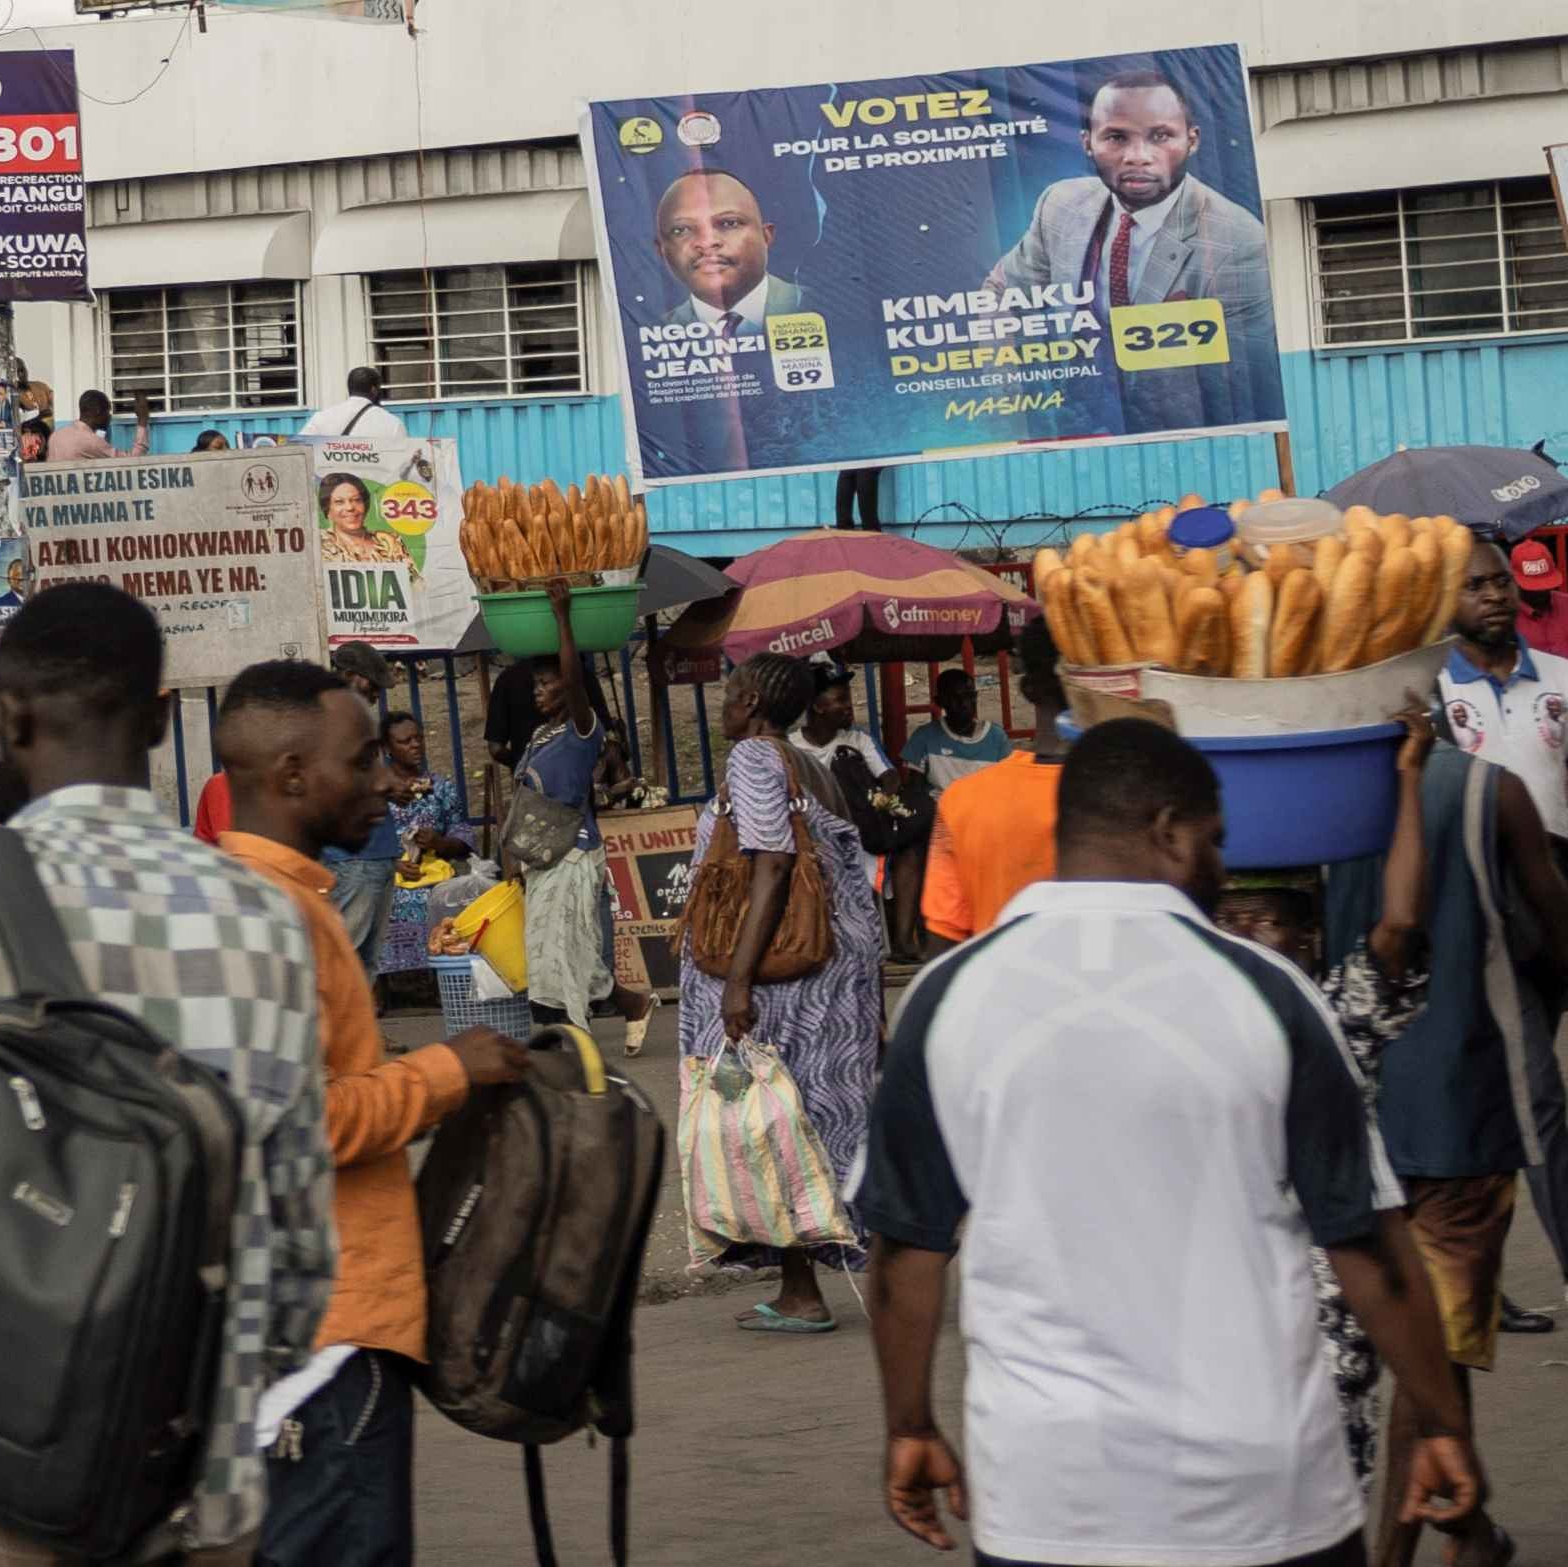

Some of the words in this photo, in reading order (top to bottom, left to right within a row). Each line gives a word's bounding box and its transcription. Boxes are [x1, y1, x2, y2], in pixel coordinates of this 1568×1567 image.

[819, 88, 993, 129] VOTEZ
[773, 137, 849, 159] POUR
[853, 134, 888, 152] LA
[893, 117, 1048, 149] SOLIDARITÉ
[882, 281, 1096, 322] KIMBAKU
[639, 320, 728, 343] NGOY
[642, 336, 766, 361] MVUNZI
[775, 336, 824, 351] 522
[886, 310, 1102, 350] KULEPETA
[1123, 319, 1219, 352] 329
[890, 337, 1102, 377] DJEFARDY
[787, 370, 822, 385] 89
[382, 499, 438, 520] 343
[38, 537, 100, 567] AZALI
[106, 527, 270, 563] KONIOKWAMA
[328, 569, 408, 610] IDIA
[769, 619, 834, 654] africell
